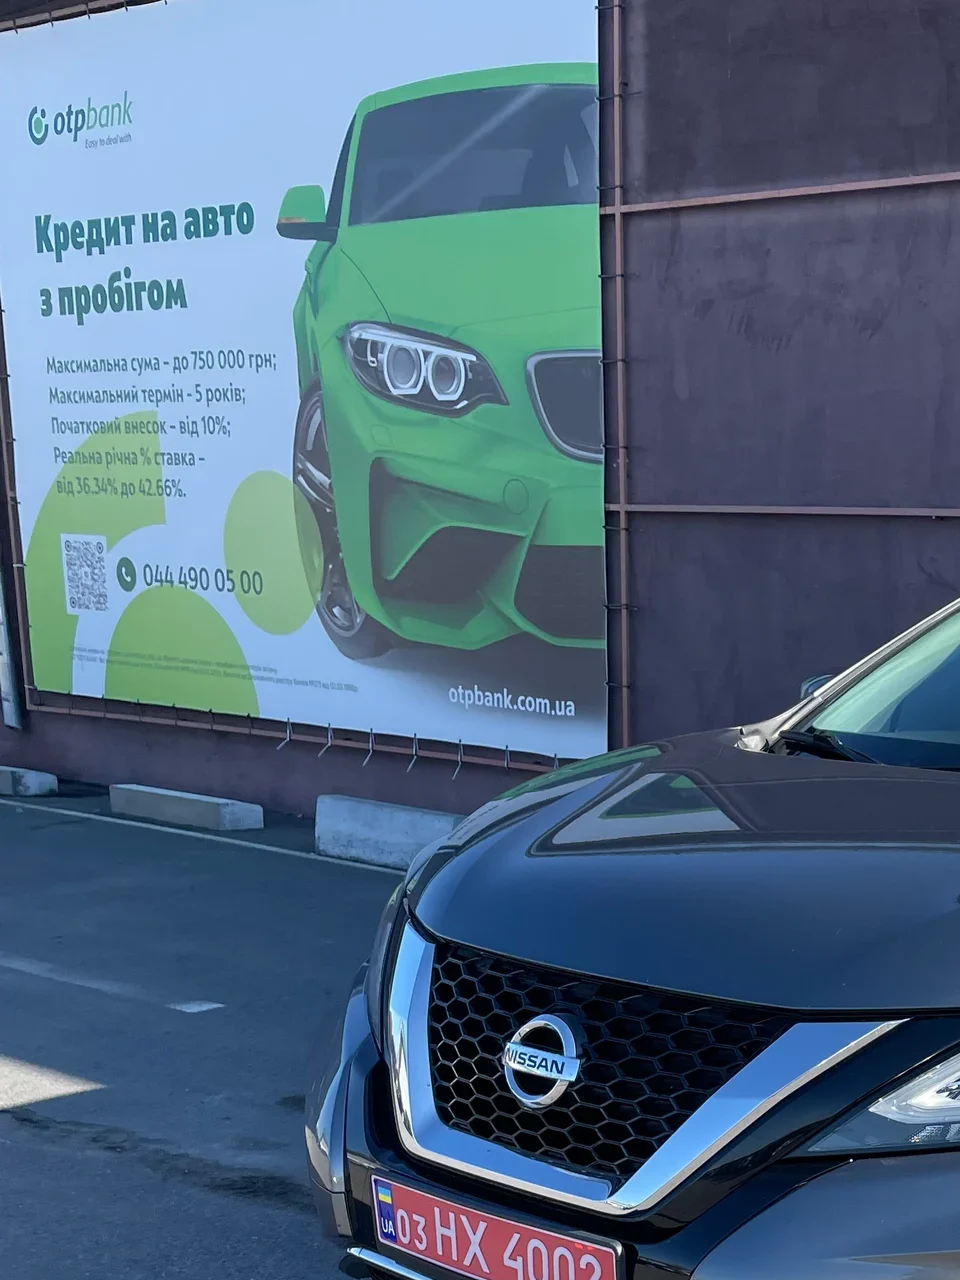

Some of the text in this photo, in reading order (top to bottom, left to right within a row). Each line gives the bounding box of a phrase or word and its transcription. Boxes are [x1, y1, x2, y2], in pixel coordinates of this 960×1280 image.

[53, 90, 132, 142] otpbank
[34, 202, 255, 263] Кредит на авто
[39, 266, 188, 326] з пробігом
[46, 356, 128, 374] Максимальна
[130, 356, 160, 377] сума
[173, 356, 189, 374] до
[190, 350, 214, 370] 750
[218, 349, 245, 369] 000
[248, 353, 277, 374] грн;
[49, 385, 139, 405] Максимальний
[141, 383, 184, 408] термін
[195, 383, 203, 403] 5
[205, 382, 246, 408] років;
[51, 416, 122, 435] Початковий
[124, 420, 168, 435] внесок
[178, 415, 200, 438] від
[201, 415, 231, 437] 10%;
[53, 446, 103, 465] Реальна
[105, 446, 138, 470] річна
[139, 446, 152, 466] %
[154, 450, 196, 467] ставка
[56, 476, 187, 499] від 36.34% до 42.66%.
[143, 563, 263, 595] 044 490 05 00
[448, 684, 576, 717] otpbank.com.ua
[506, 1047, 566, 1075] NISSAN
[381, 1217, 396, 1237] UA
[396, 1208, 428, 1251] 03
[434, 1206, 491, 1275] HX
